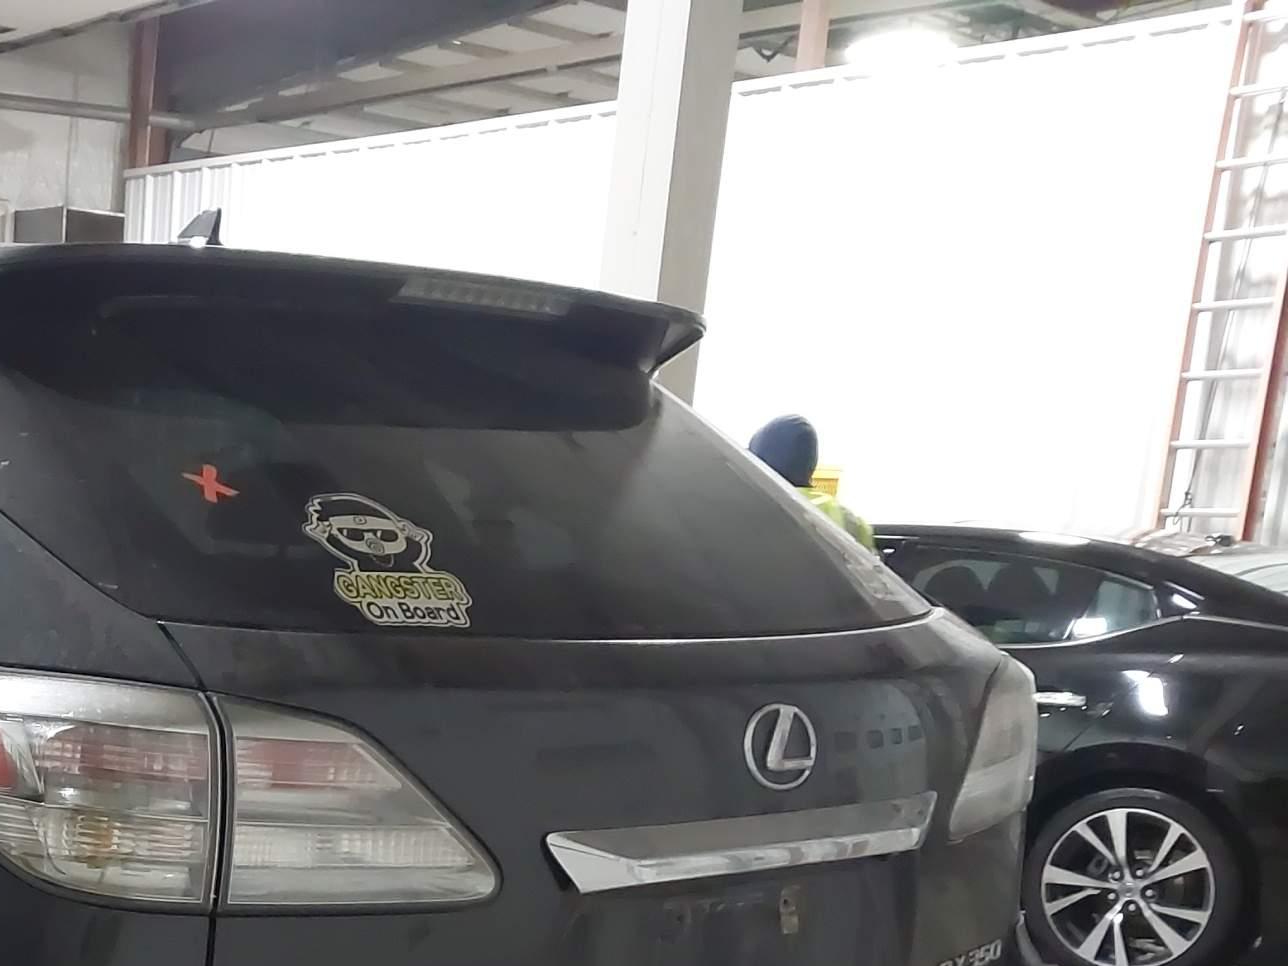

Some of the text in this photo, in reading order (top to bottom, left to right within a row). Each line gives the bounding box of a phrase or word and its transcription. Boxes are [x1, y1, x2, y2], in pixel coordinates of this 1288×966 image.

[336, 574, 463, 601] GANGSTER
[366, 602, 460, 621] On Board
